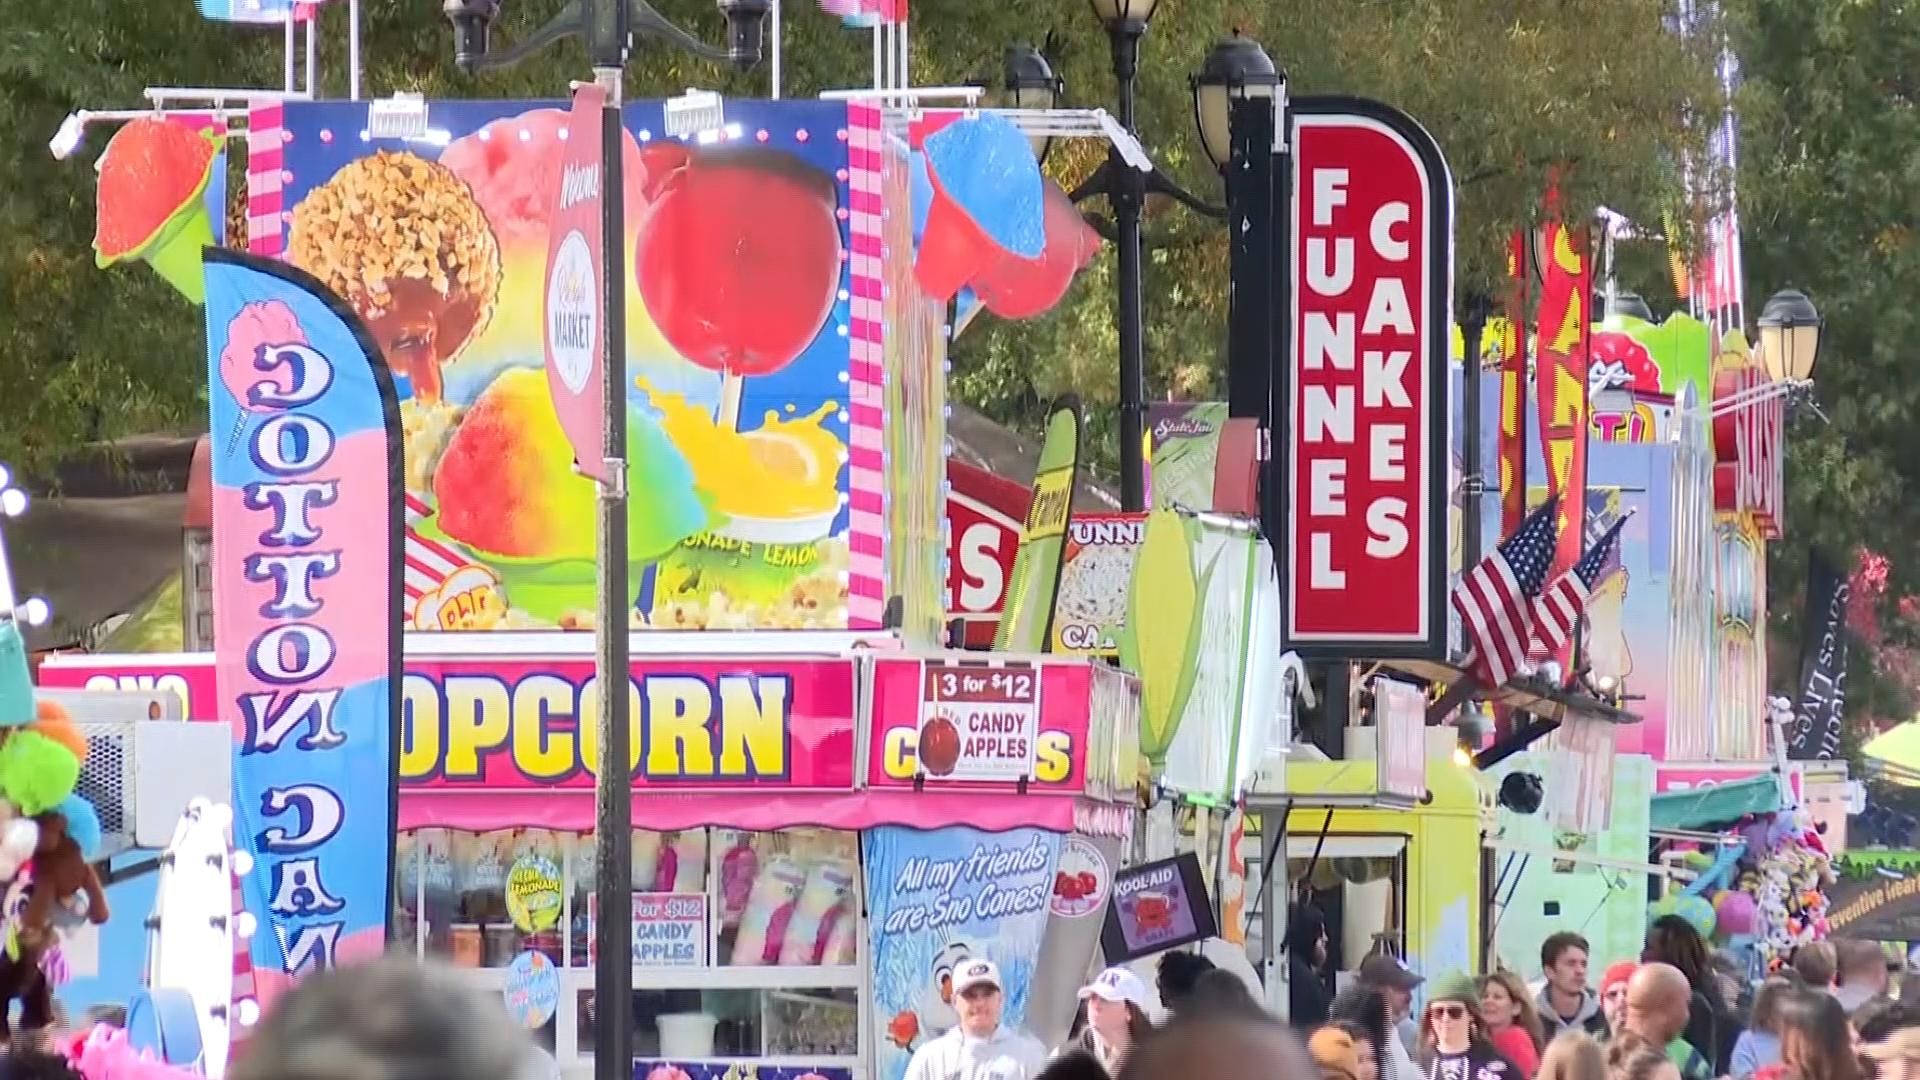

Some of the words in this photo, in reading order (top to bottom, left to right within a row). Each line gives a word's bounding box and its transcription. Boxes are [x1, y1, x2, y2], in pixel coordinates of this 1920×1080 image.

[555, 311, 590, 349] MARKET
[1304, 168, 1355, 590] FUNNEL
[1362, 202, 1415, 558] CAKES
[1818, 577, 1850, 669] Saves
[941, 673, 958, 696] 3
[962, 675, 987, 692] for
[991, 673, 1031, 698] $12
[1791, 669, 1834, 749] Lives
[968, 712, 1026, 734] CANDY
[963, 738, 1028, 759] APPLES
[511, 878, 560, 897] LEMONADE
[898, 857, 928, 893] All
[927, 859, 965, 893] my
[964, 833, 1048, 882] friends
[884, 904, 927, 935] are
[928, 893, 972, 928] Sno
[976, 875, 1050, 919] Cones!
[637, 922, 694, 940] CANDY
